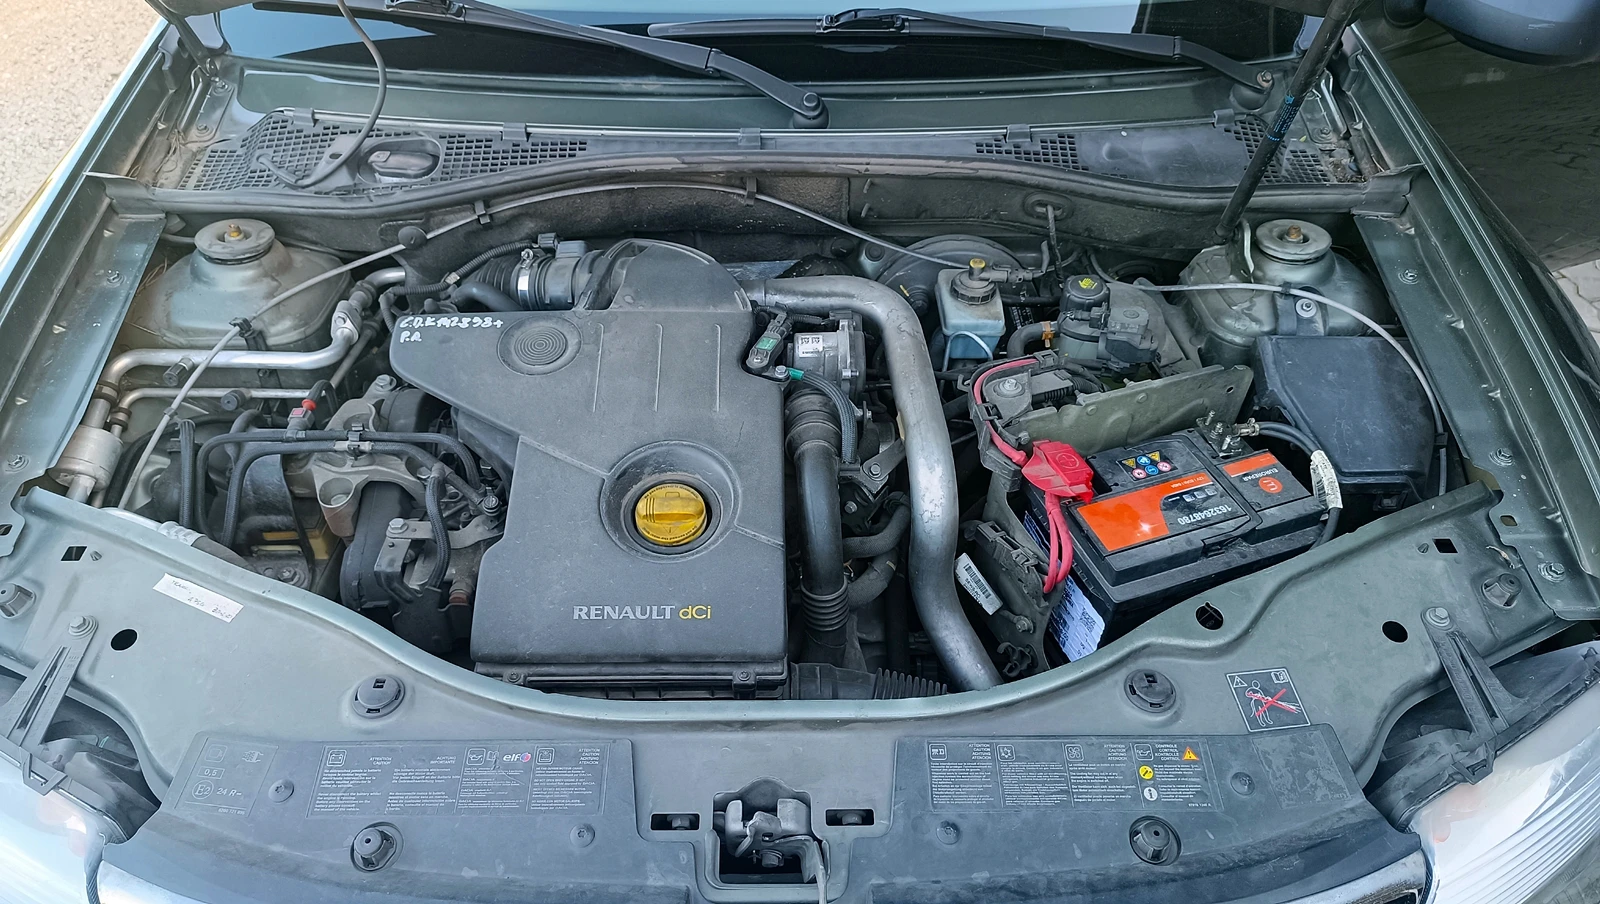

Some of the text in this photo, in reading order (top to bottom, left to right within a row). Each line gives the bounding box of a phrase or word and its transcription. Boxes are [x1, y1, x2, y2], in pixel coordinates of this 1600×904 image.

[573, 604, 712, 620] RENAULT dCi
[502, 753, 521, 762] elf
[204, 768, 218, 777] 0,5
[194, 784, 211, 795] E2
[216, 787, 228, 795] 24
